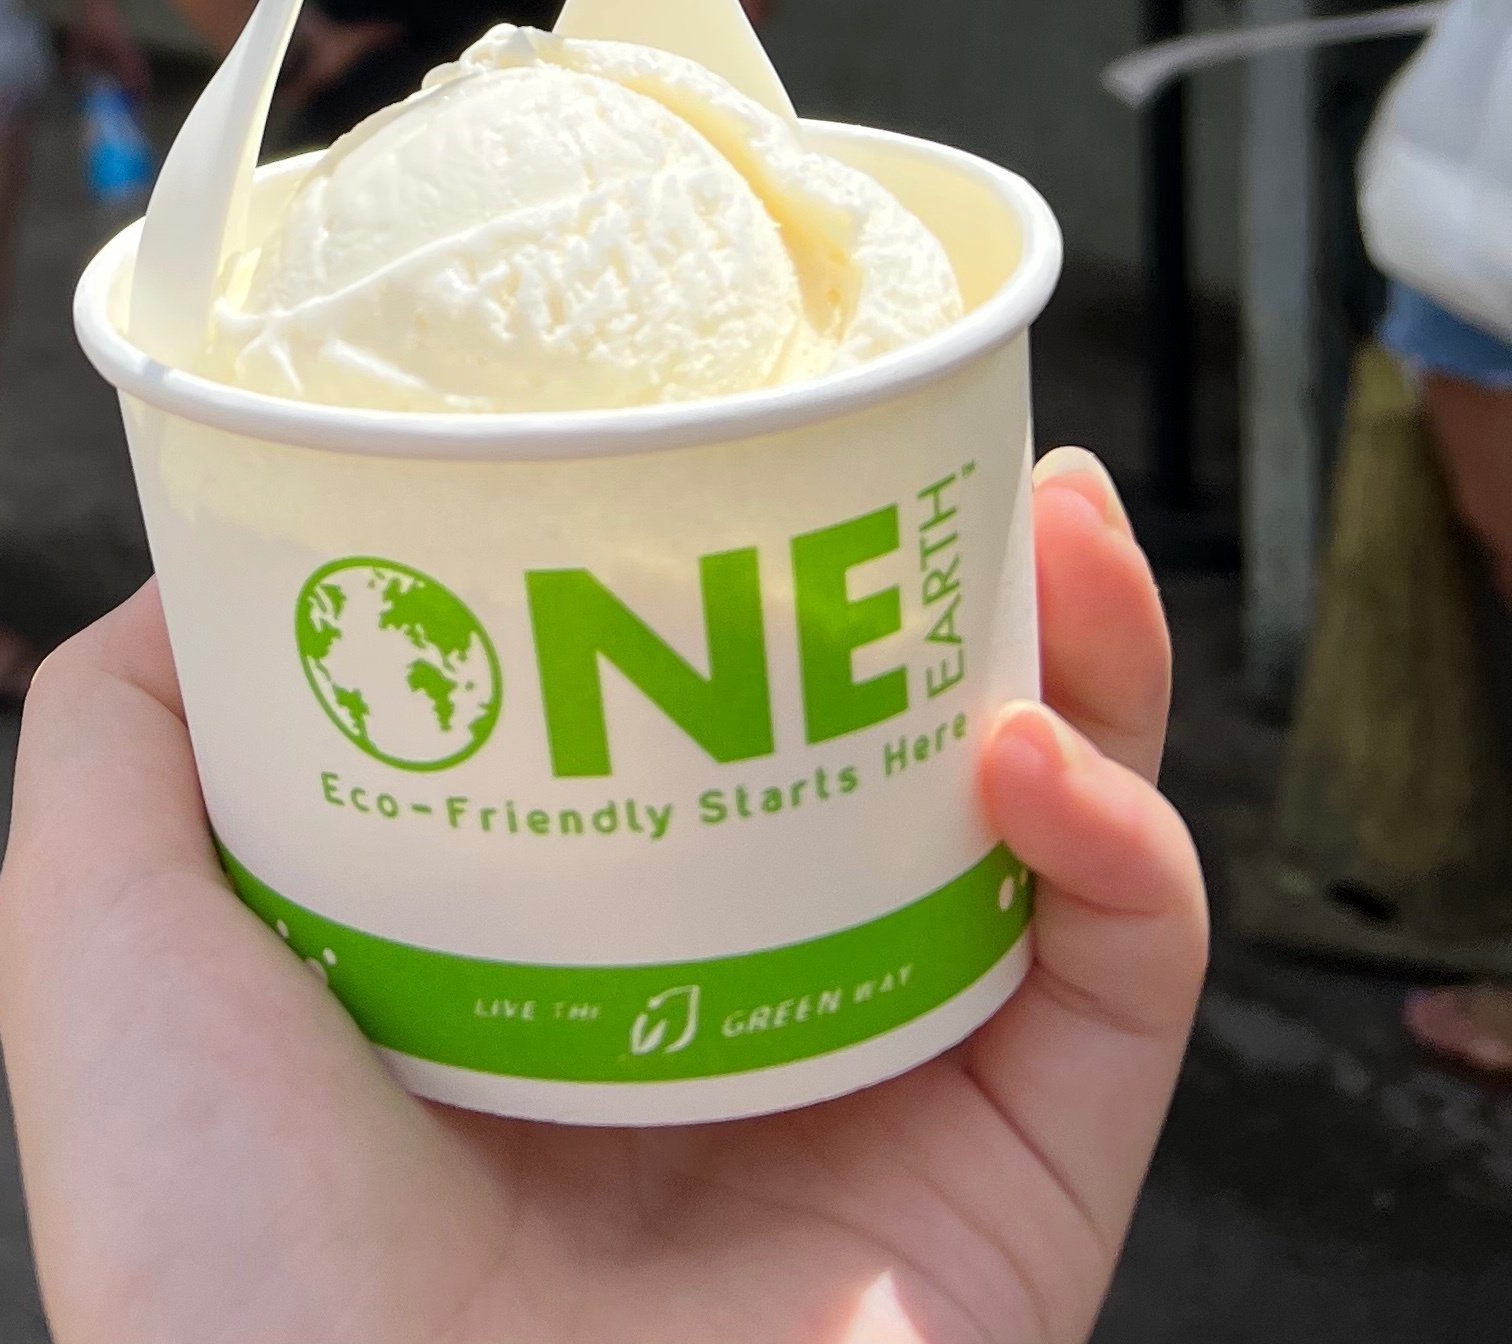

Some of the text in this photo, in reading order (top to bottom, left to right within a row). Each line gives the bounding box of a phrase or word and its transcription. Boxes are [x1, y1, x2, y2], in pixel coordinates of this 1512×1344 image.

[319, 712, 969, 840] Eco-Friendly Starts Here
[473, 997, 536, 1021] LIVE
[720, 987, 842, 1038] GREEN
